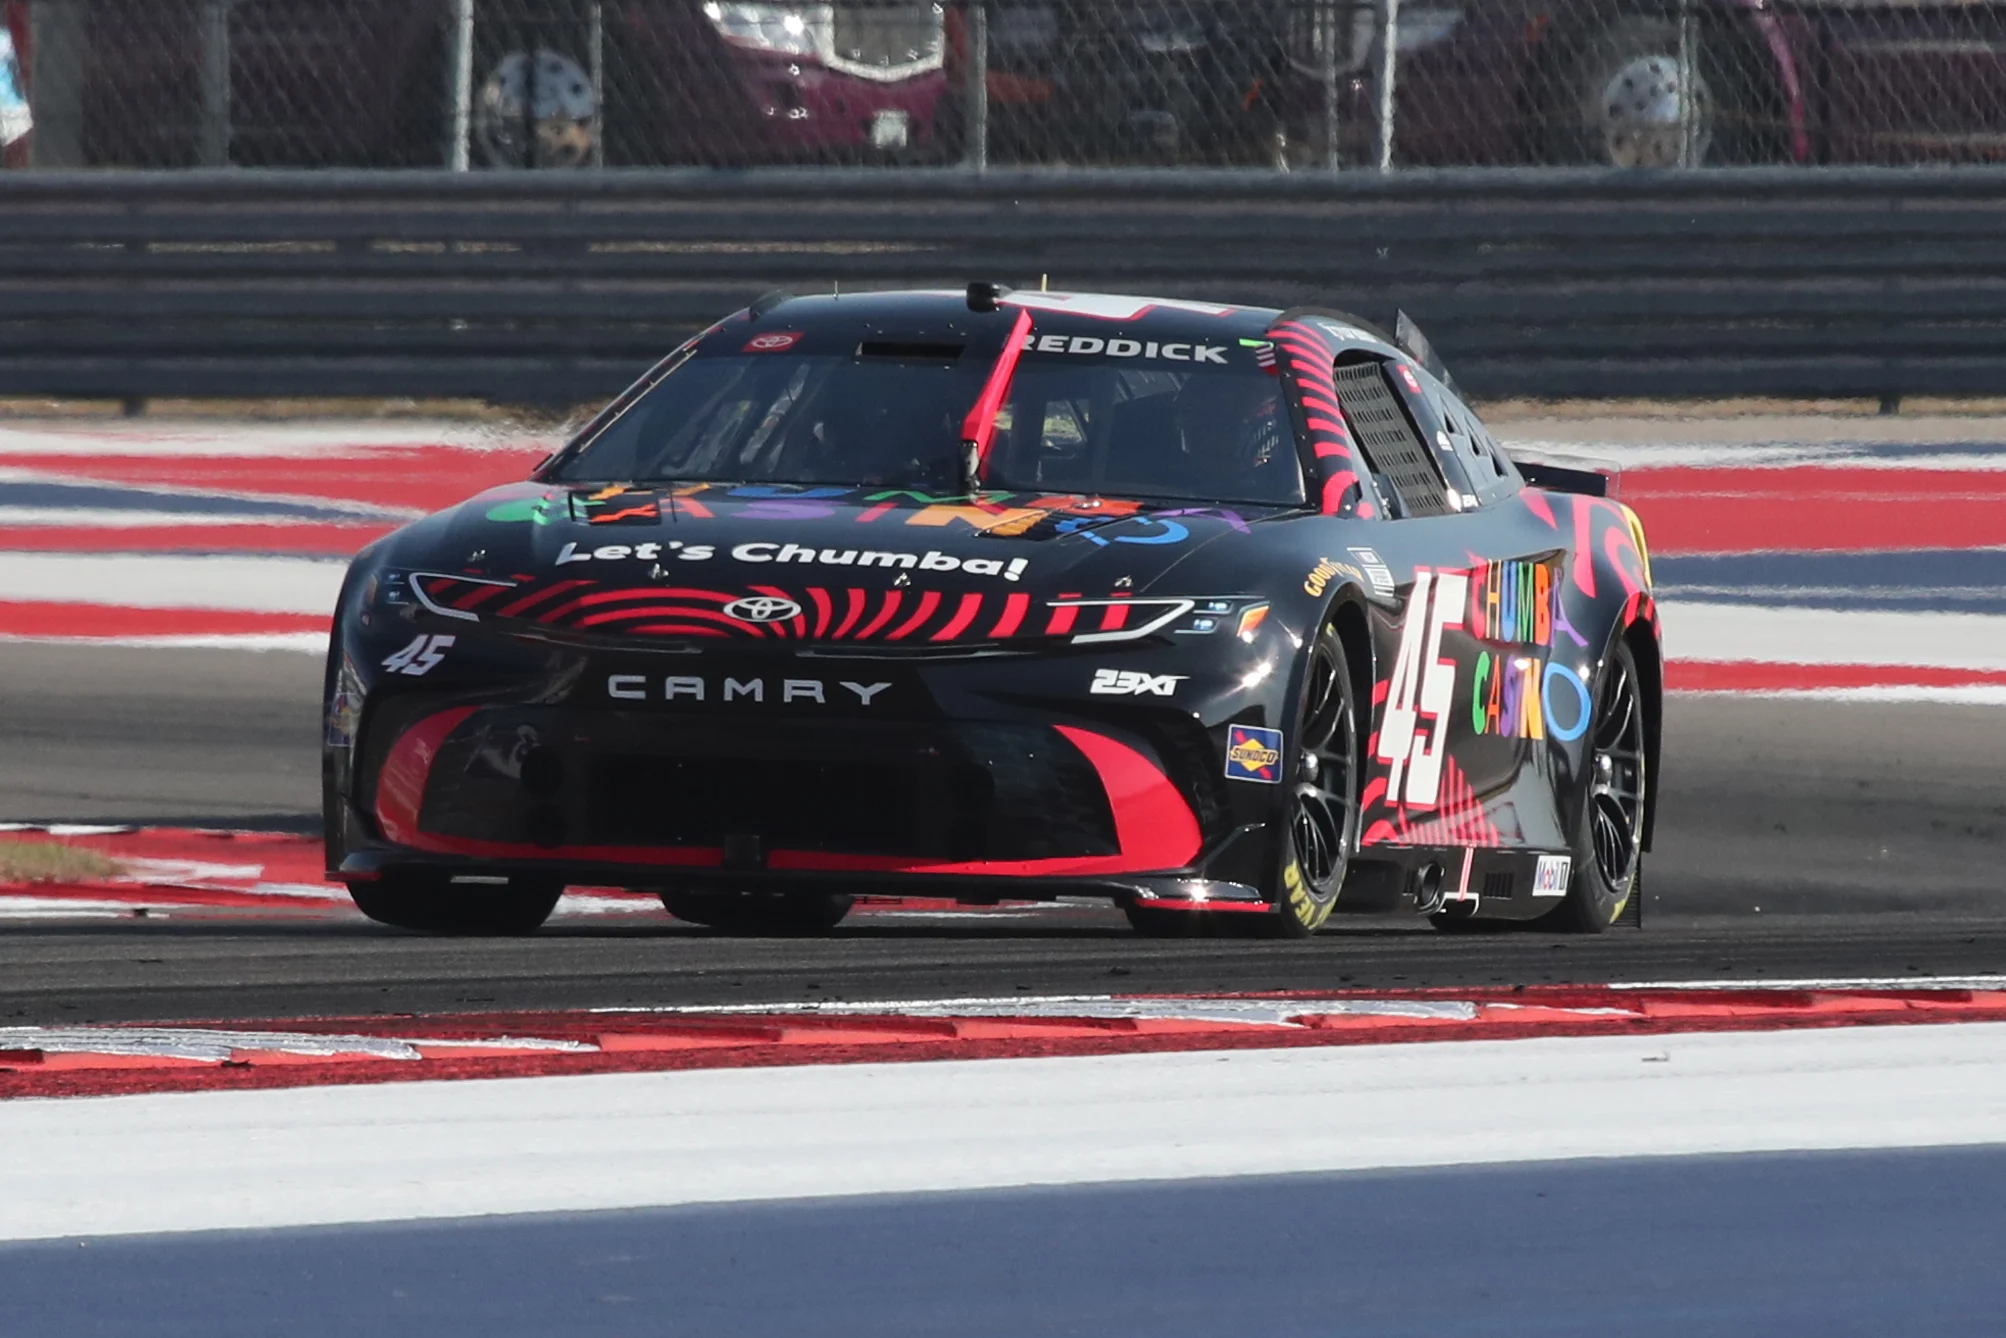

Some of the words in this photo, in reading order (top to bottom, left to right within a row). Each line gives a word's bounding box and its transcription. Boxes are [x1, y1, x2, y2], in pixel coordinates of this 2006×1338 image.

[555, 541, 715, 565] Let's
[731, 543, 1028, 584] Chumba!
[1471, 558, 1590, 649] CHUMBA
[381, 634, 457, 676] 45
[608, 674, 893, 705] CAMRY
[1377, 566, 1468, 811] 45
[1472, 651, 1592, 742] CASINO
[1231, 747, 1277, 764] SUNOCO
